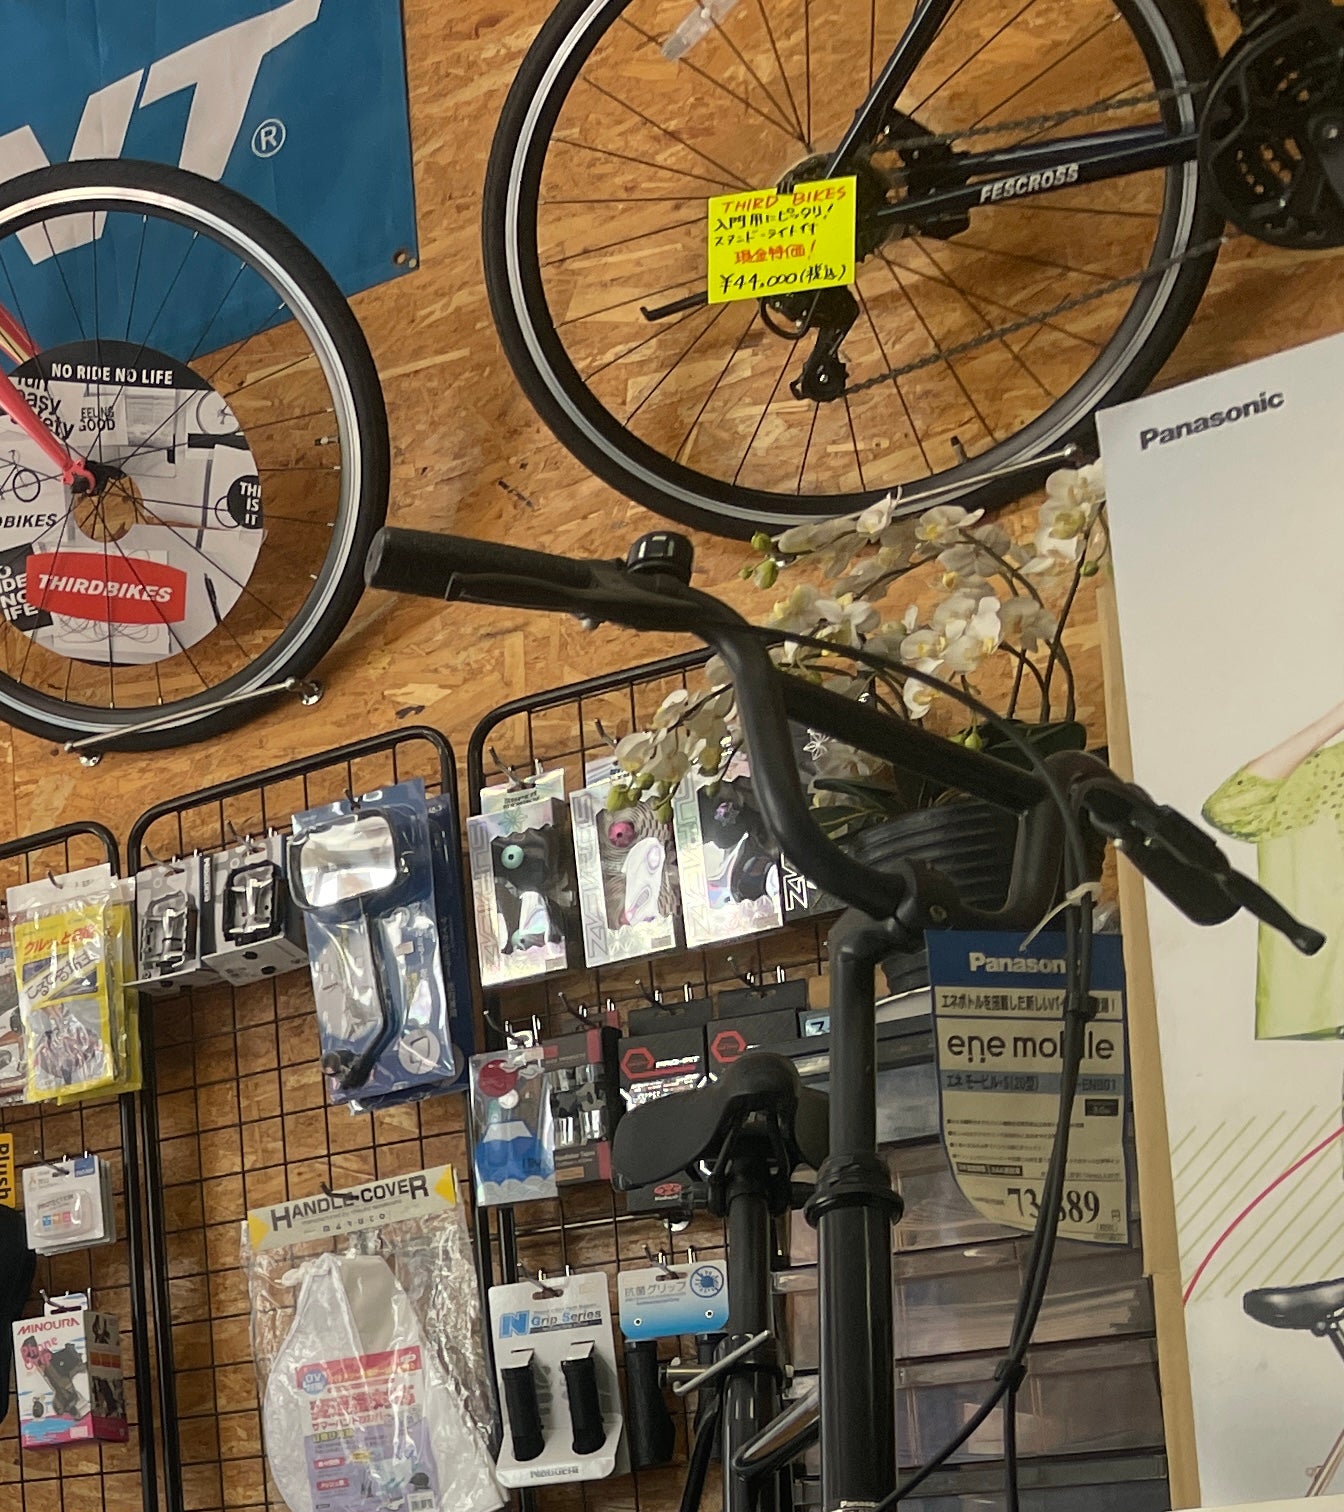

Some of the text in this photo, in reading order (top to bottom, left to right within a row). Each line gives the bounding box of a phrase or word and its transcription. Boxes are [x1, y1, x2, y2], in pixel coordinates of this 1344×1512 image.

[979, 164, 1079, 204] FESCROSS
[722, 186, 846, 213] THIRD BIKES
[51, 363, 173, 385] NO RIDE NO LIFE
[1140, 390, 1285, 450] Panasonic
[38, 573, 174, 603] THIRDBIKES
[624, 1281, 688, 1298] 抗菌グリップ
[17, 1316, 81, 1336] MINOURA
[531, 1315, 558, 1330] Grip
[562, 1309, 602, 1322] Series
